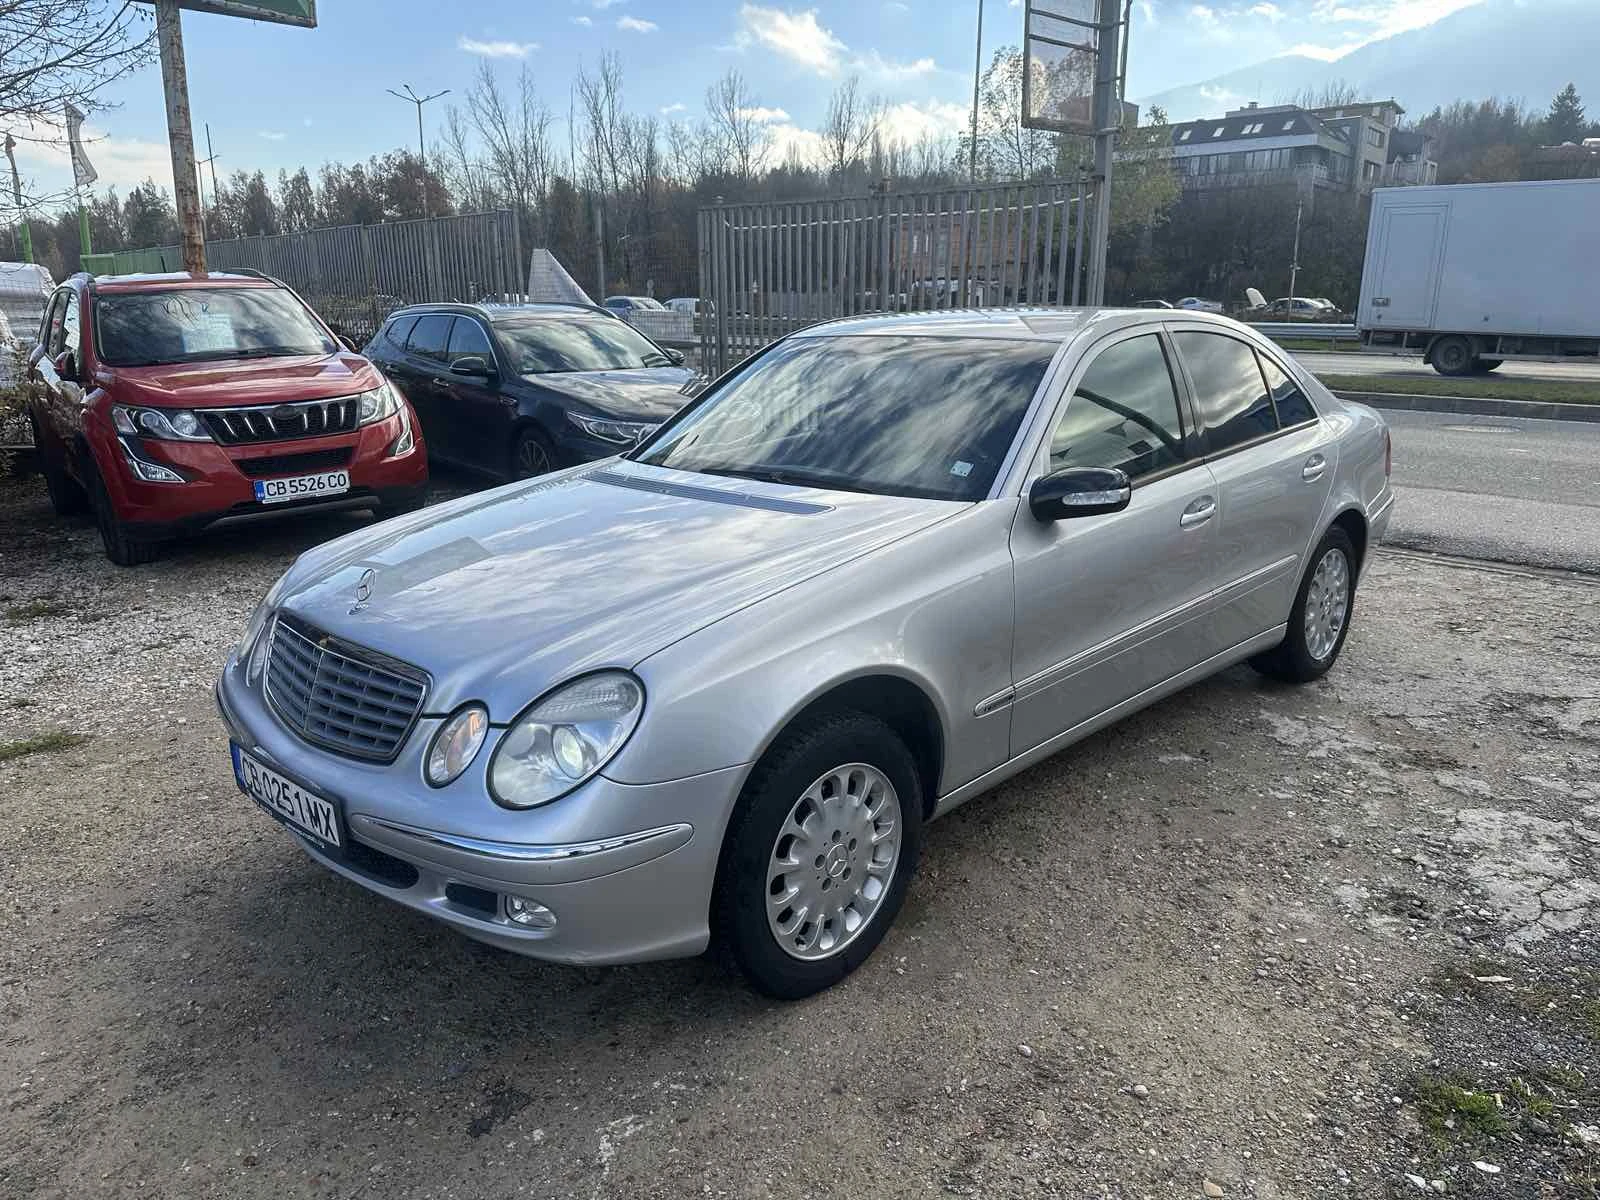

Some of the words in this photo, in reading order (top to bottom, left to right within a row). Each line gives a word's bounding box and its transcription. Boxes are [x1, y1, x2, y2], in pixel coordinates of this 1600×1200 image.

[266, 481, 287, 496] CB
[289, 476, 325, 493] 5526
[328, 473, 347, 488] CO
[242, 756, 262, 796] CB
[262, 771, 306, 824] 0251
[305, 796, 337, 842] MX
